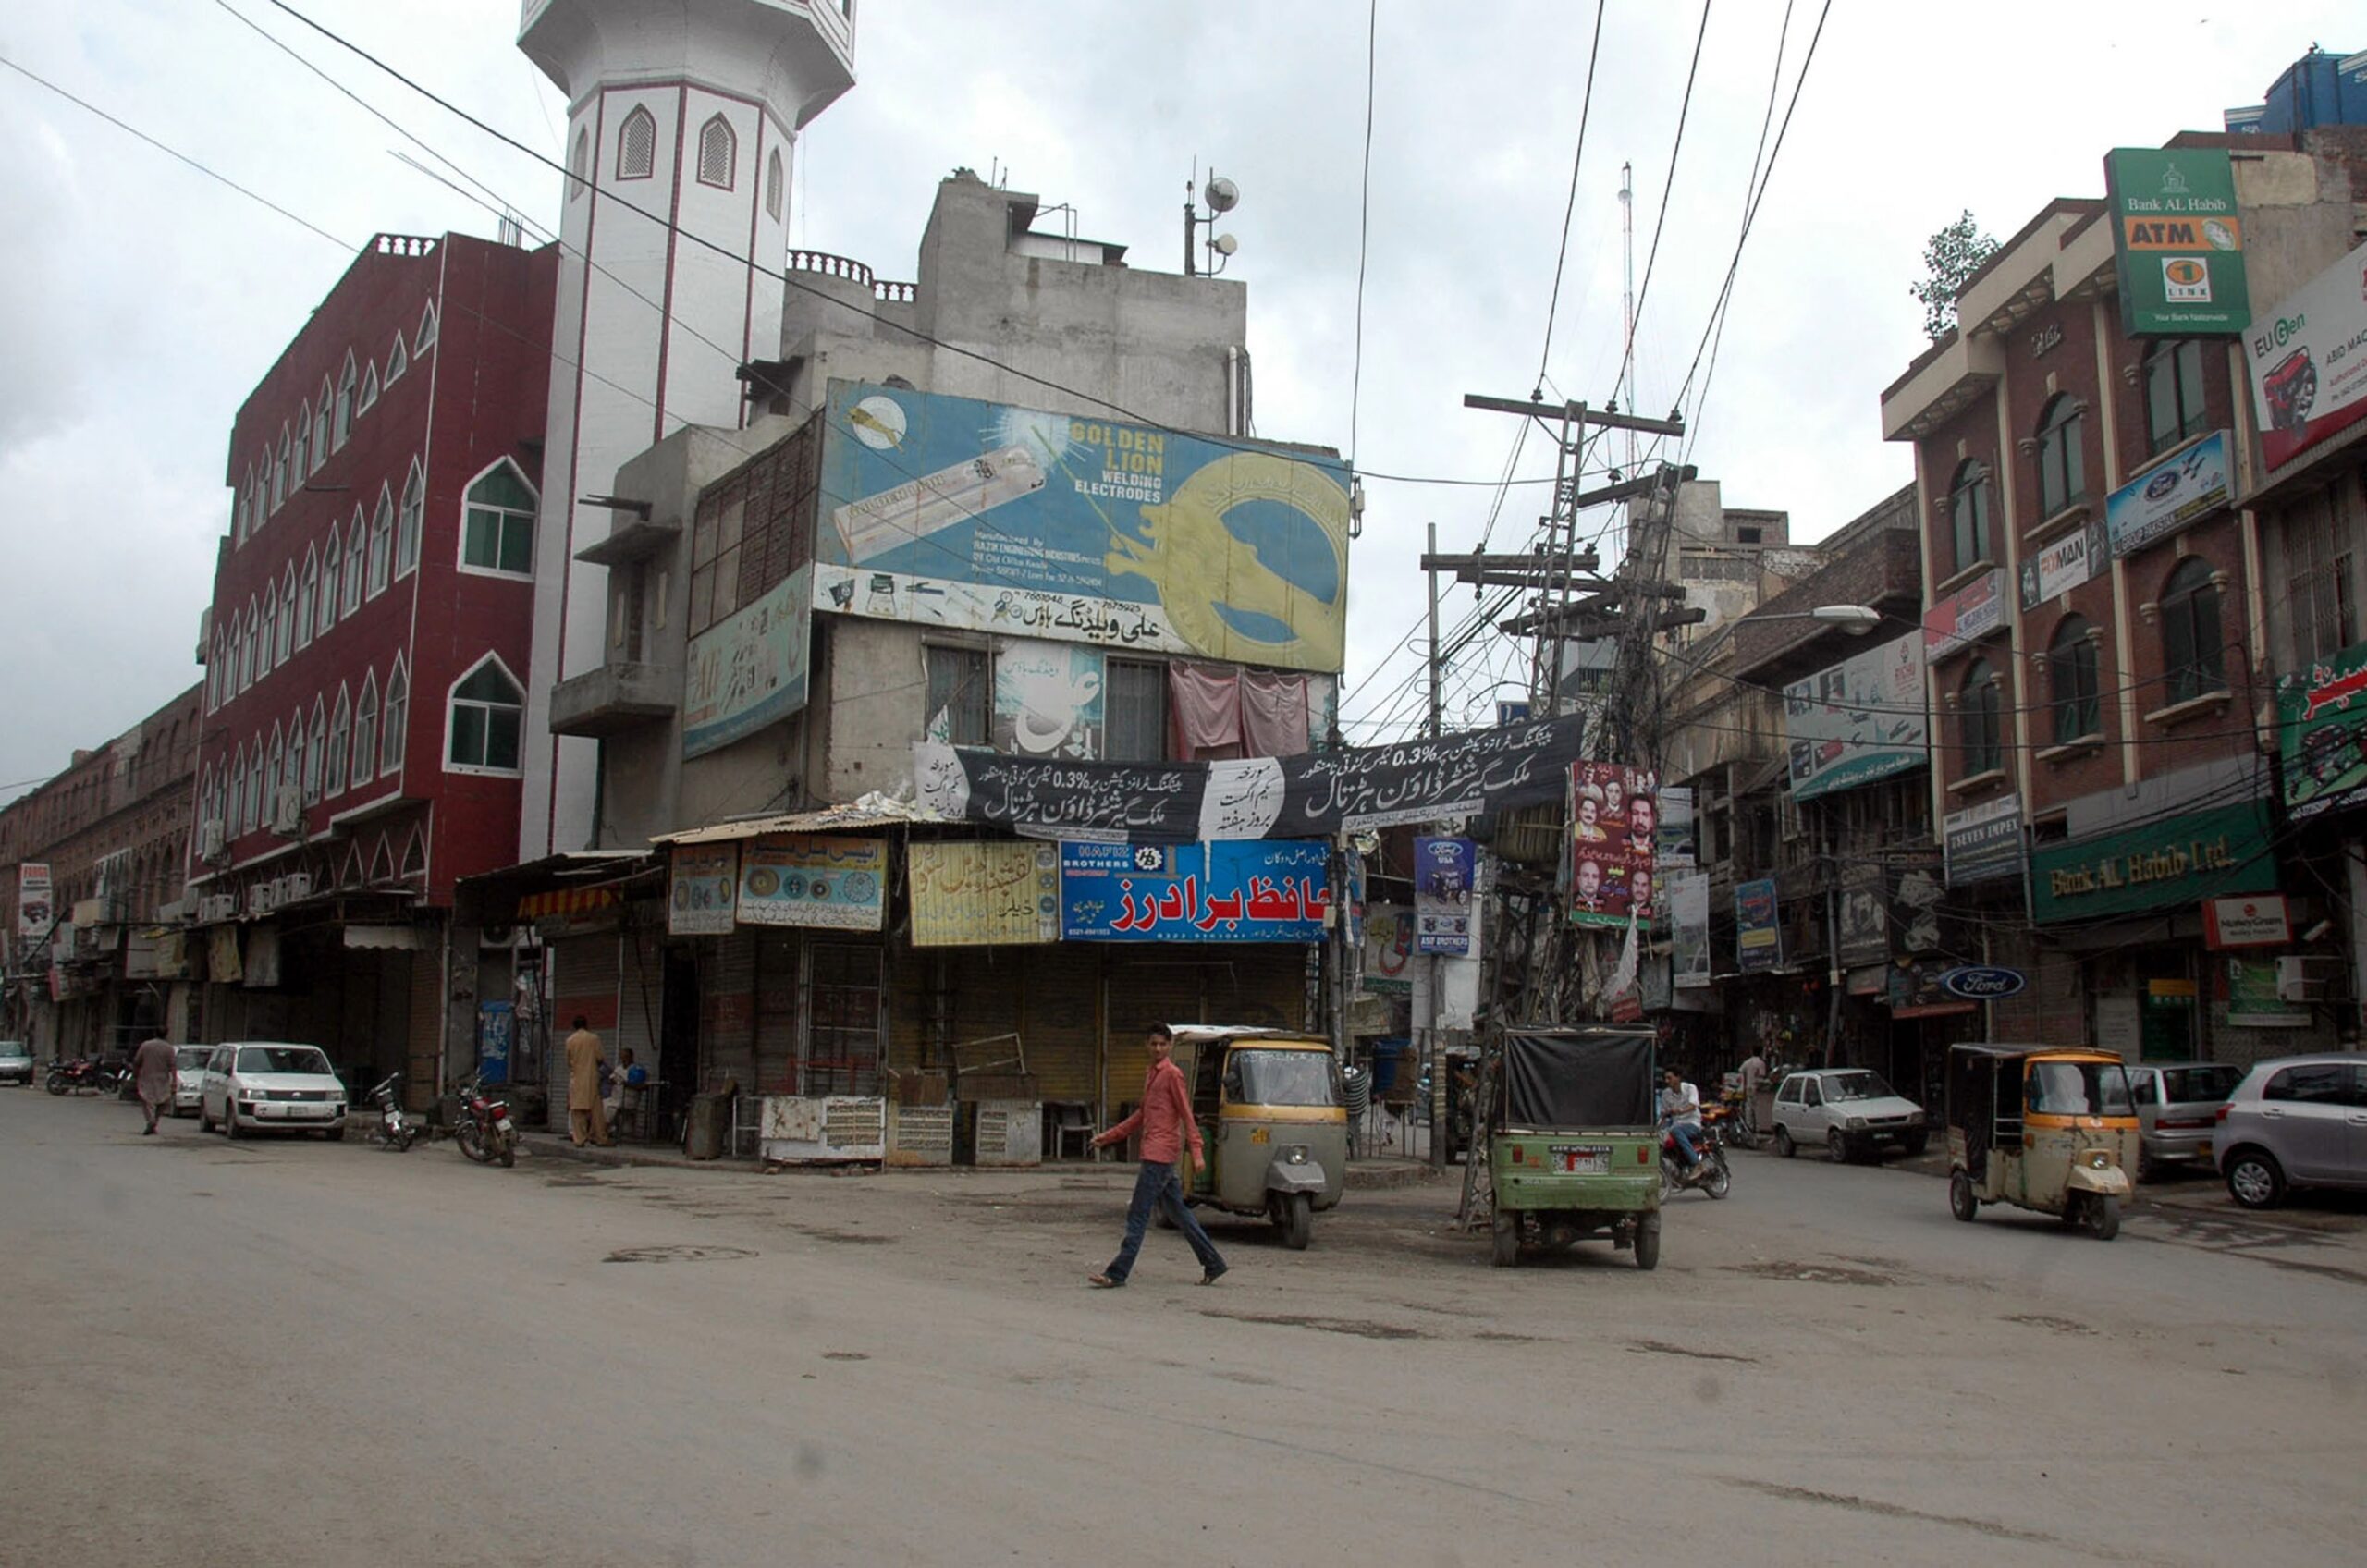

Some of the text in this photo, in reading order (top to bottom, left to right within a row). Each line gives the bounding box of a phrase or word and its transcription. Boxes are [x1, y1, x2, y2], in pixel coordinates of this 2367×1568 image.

[2128, 198, 2226, 211] Bank AL Habib
[2131, 223, 2195, 243] ATM
[2168, 288, 2207, 296] LINK
[1071, 422, 1164, 455] GOLDEN
[1107, 448, 1162, 475] LION
[1102, 470, 1161, 490] WELDING
[1074, 479, 1161, 504] ELECTRODES
[1122, 611, 1161, 643] علی
[1392, 745, 1437, 766] 0.3%
[1053, 770, 1088, 790] 0.3%
[1235, 765, 1271, 781] مورخہ
[985, 785, 1039, 822] ہڑتال
[1305, 775, 1374, 817] ہڑتال
[1216, 809, 1272, 832] بروز ہفتہ
[1078, 845, 1130, 858] HAFIZ
[1063, 860, 1129, 868] BROTHERS
[2050, 864, 2095, 898] Bank
[2098, 858, 2124, 888] AL
[2128, 843, 2189, 883] Habib
[1110, 874, 1243, 932] برادرز
[2221, 916, 2282, 927] MoneyGram
[1962, 973, 2008, 994] Ford
